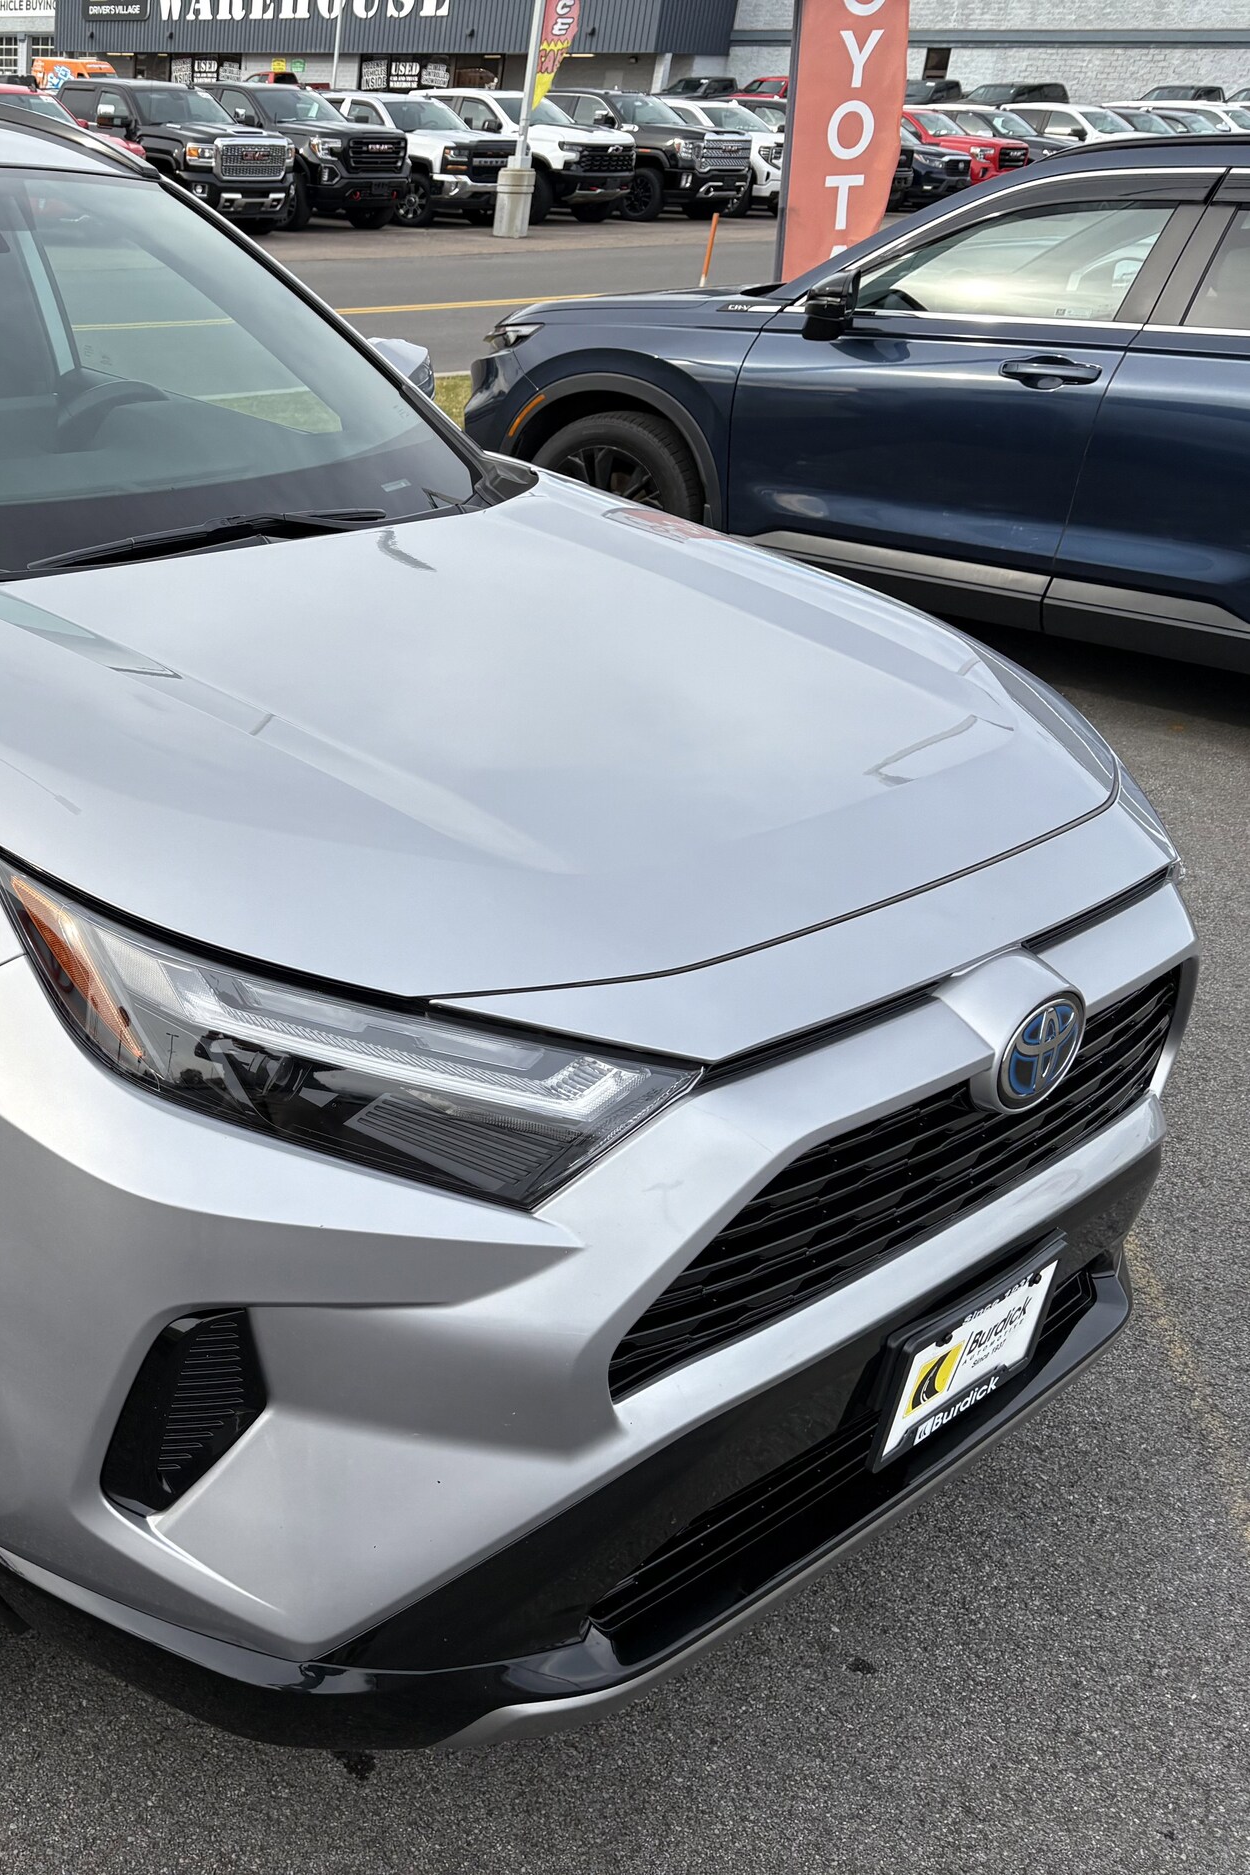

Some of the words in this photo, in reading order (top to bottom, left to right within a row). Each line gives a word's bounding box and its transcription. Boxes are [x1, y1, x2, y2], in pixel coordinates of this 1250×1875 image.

[115, 5, 141, 14] VILLAGE
[195, 60, 217, 71] USED
[391, 62, 420, 75] USED
[362, 76, 387, 89] INSIDE
[966, 1296, 1032, 1356] Burdick
[962, 1318, 1024, 1366] AUTOMOTIVE
[971, 1350, 990, 1368] Since
[931, 1375, 1000, 1430] Burdick
